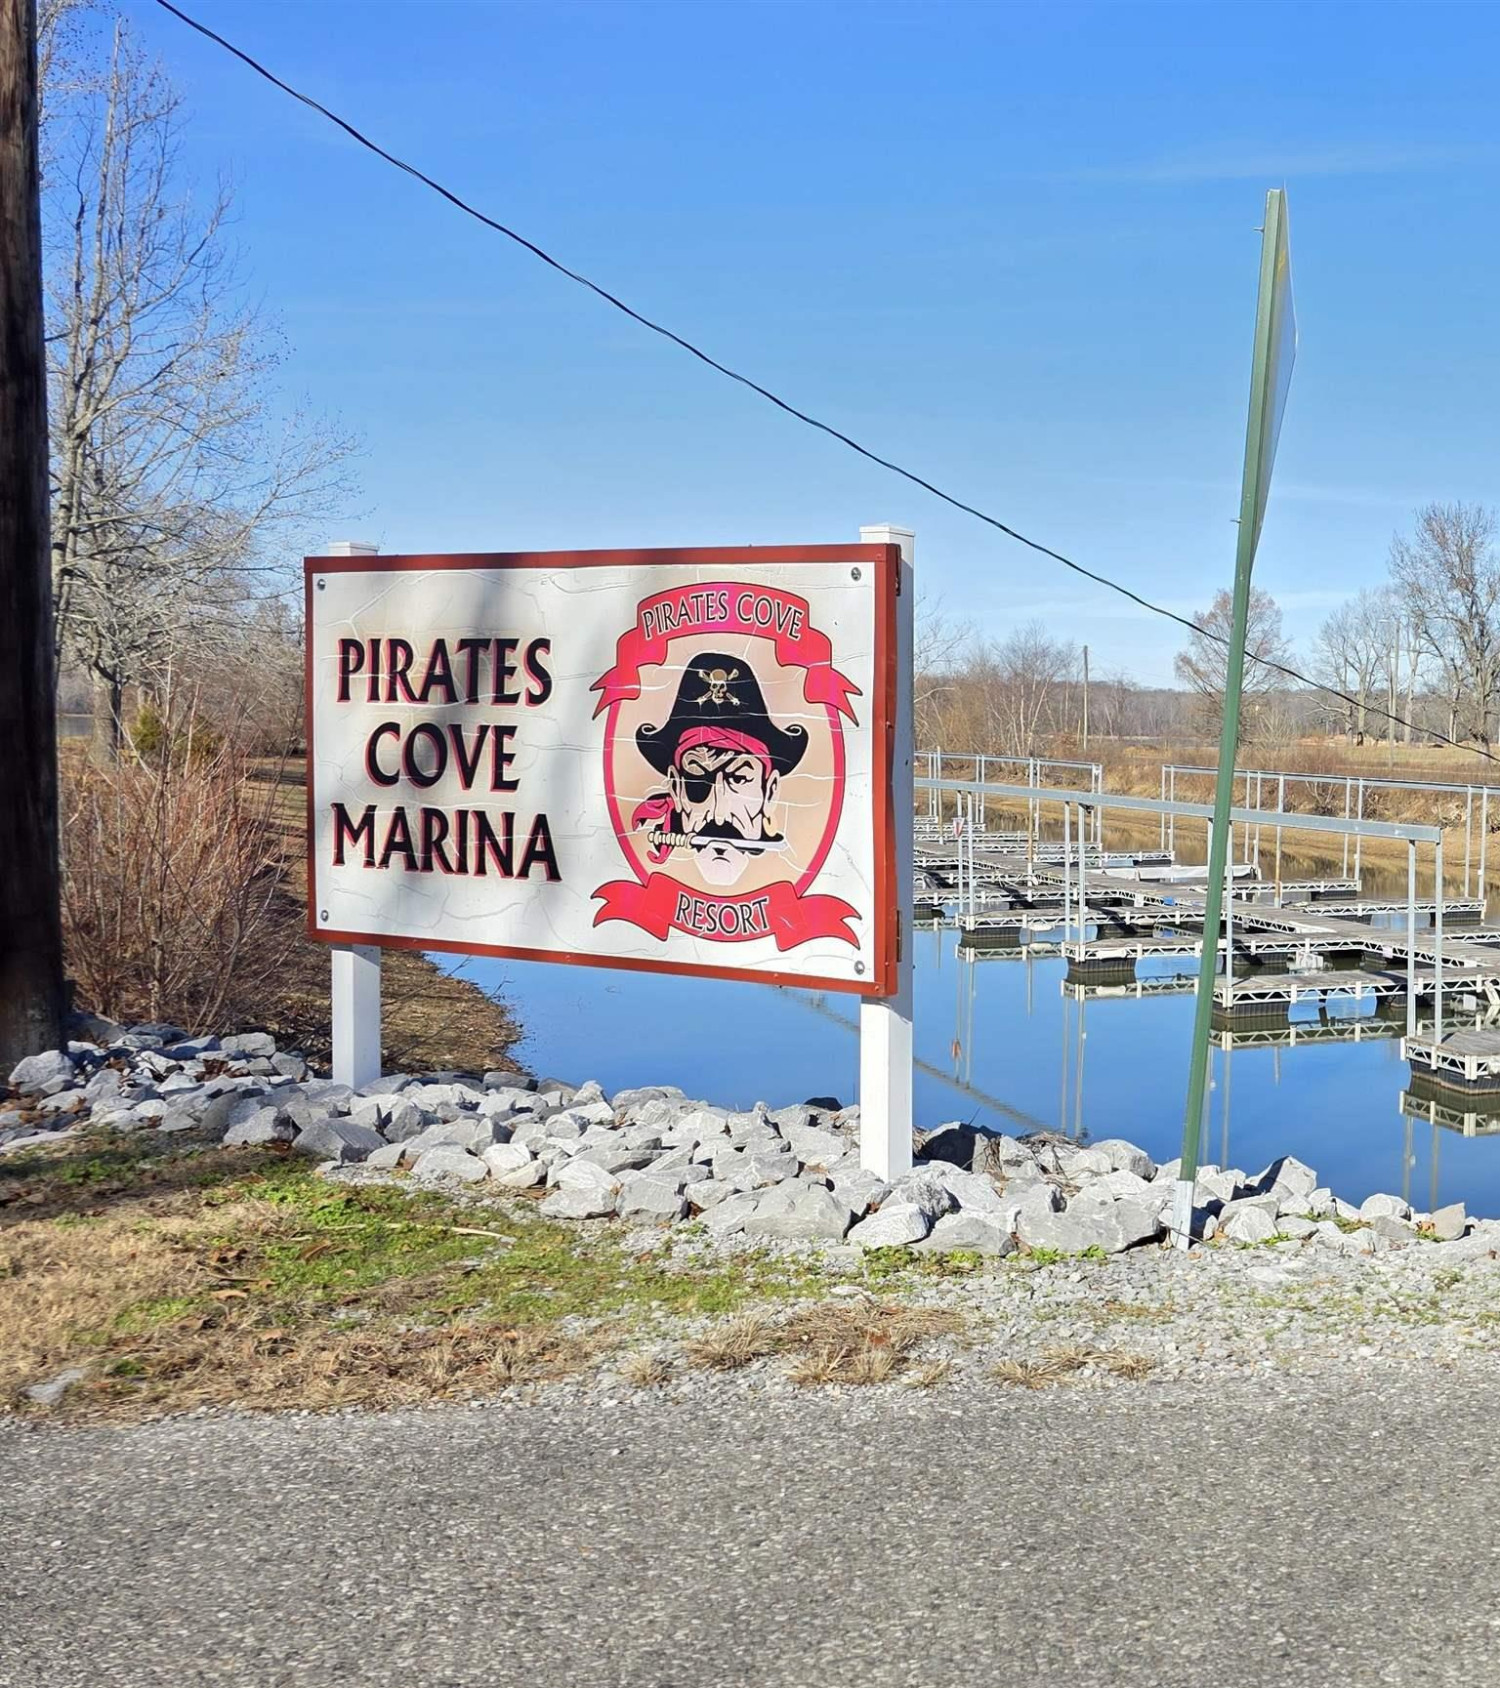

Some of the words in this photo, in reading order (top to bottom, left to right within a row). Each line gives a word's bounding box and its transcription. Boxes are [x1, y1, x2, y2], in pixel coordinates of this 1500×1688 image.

[642, 591, 729, 640] PIRATES
[737, 593, 803, 640] COVE
[337, 637, 553, 707] PIRATES
[365, 721, 521, 793] COVE
[331, 802, 563, 882] MARINA
[675, 893, 768, 934] RESORT
